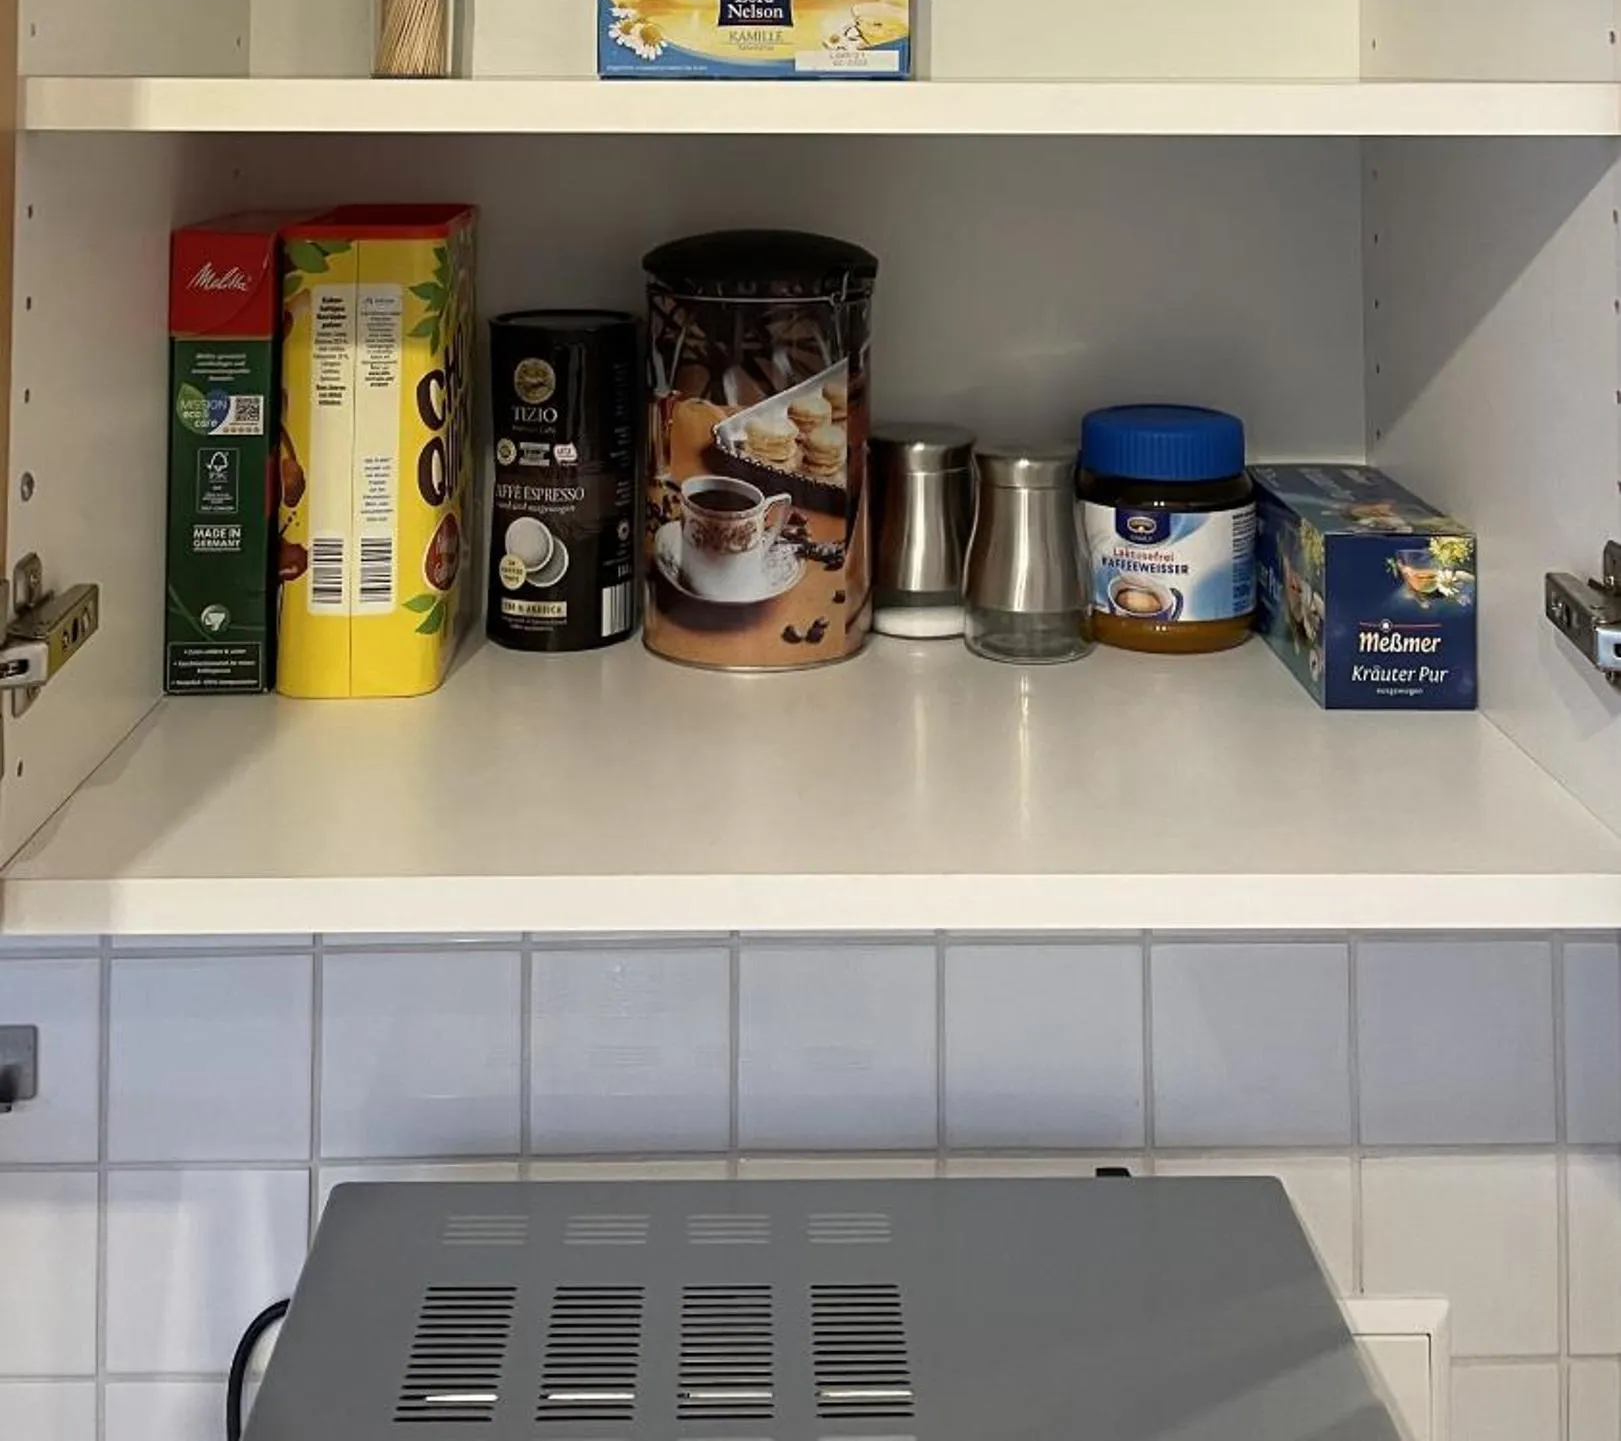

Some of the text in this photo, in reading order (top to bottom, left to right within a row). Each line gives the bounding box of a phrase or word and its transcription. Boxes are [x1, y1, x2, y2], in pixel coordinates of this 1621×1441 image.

[727, 4, 784, 20] Nelson
[729, 30, 784, 43] KAMILLE
[186, 261, 248, 292] Melitta
[180, 399, 228, 410] MISSION
[511, 405, 558, 424] TIZIO
[194, 419, 218, 429] care
[496, 483, 585, 503] AFFÈ ESPRESSO
[193, 527, 241, 538] MADE IN
[193, 539, 241, 547] GERMANY
[1113, 546, 1175, 563] Laktosefrei
[1102, 557, 1190, 575] KAFFEEWEISSER
[1358, 631, 1442, 653] Meßmer
[1351, 664, 1450, 683] Kräuter Pur
